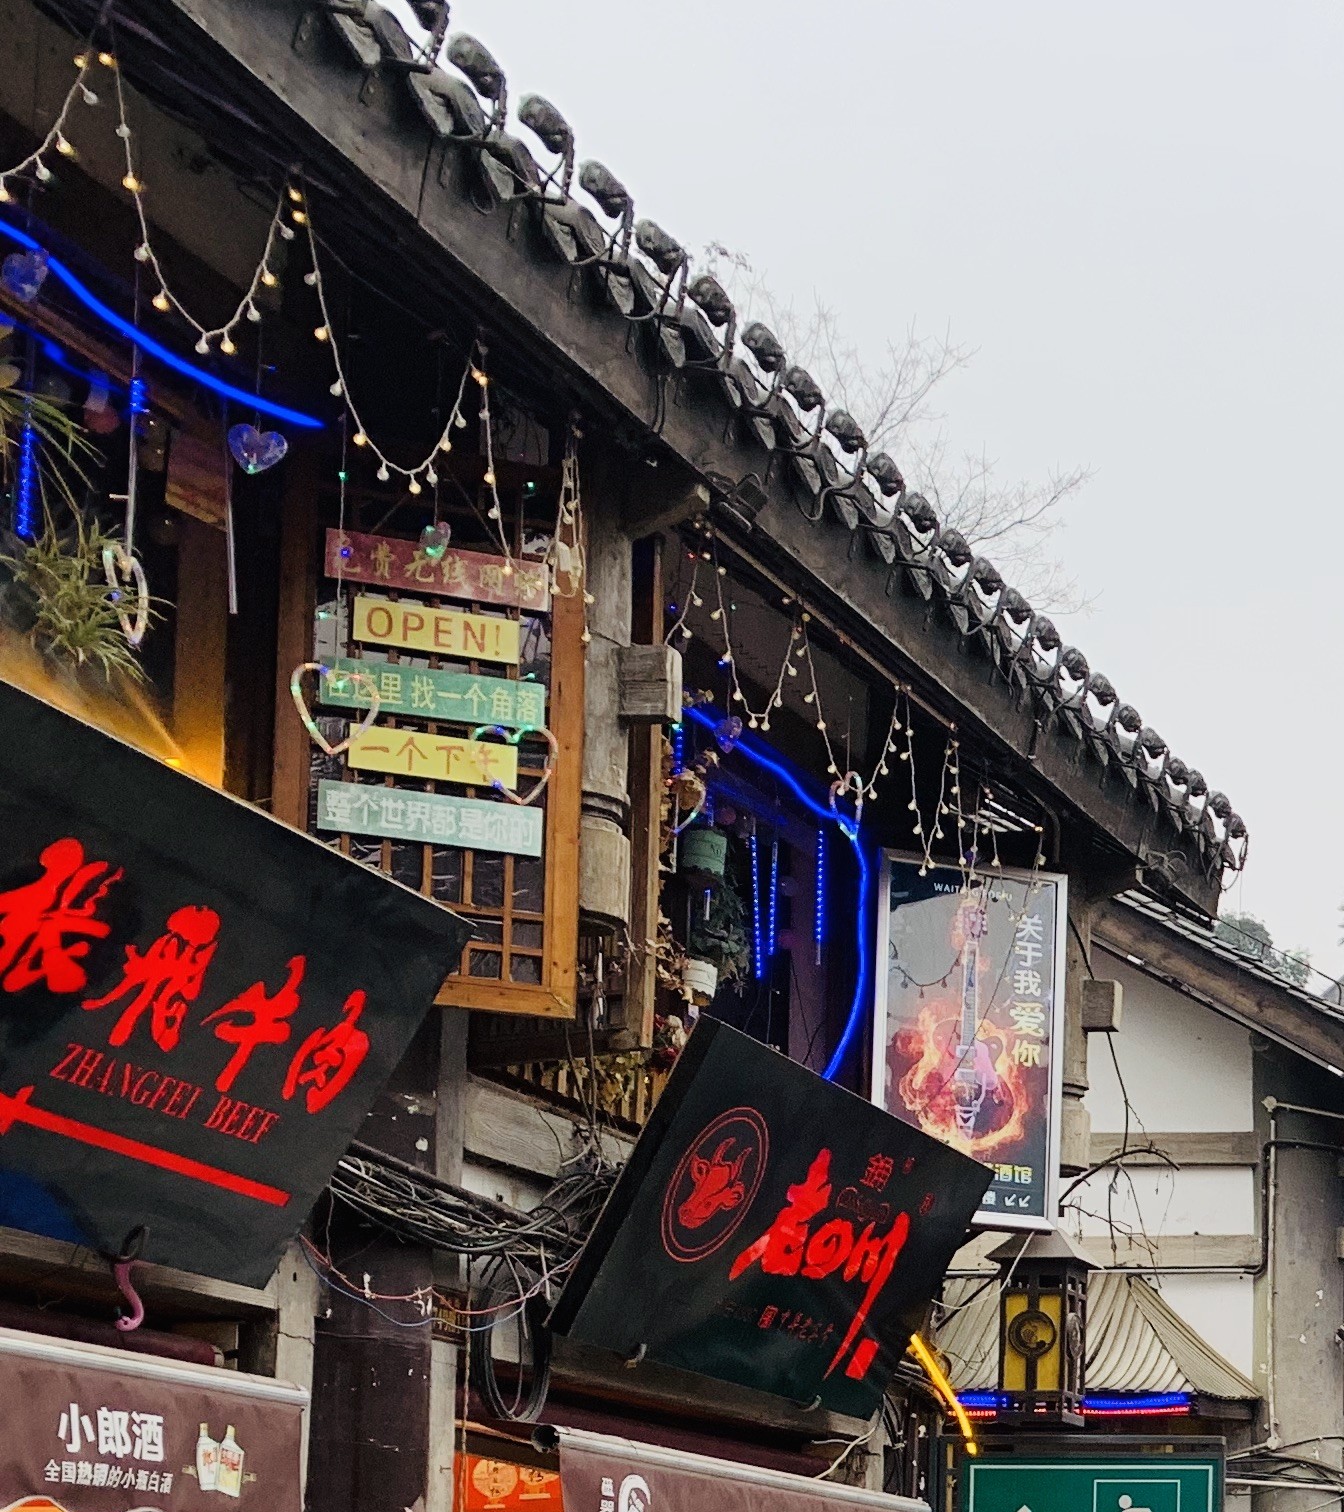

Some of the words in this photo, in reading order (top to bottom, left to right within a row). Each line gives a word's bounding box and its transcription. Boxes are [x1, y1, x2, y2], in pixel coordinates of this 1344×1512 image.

[366, 606, 502, 657] OPEN!
[324, 788, 535, 849] 整个世界都是你的
[1009, 913, 1045, 1068] 关于我爱你
[49, 1042, 204, 1119] ZHANGFEI
[205, 1093, 280, 1145] BEEF
[58, 1402, 165, 1463] 小郎酒
